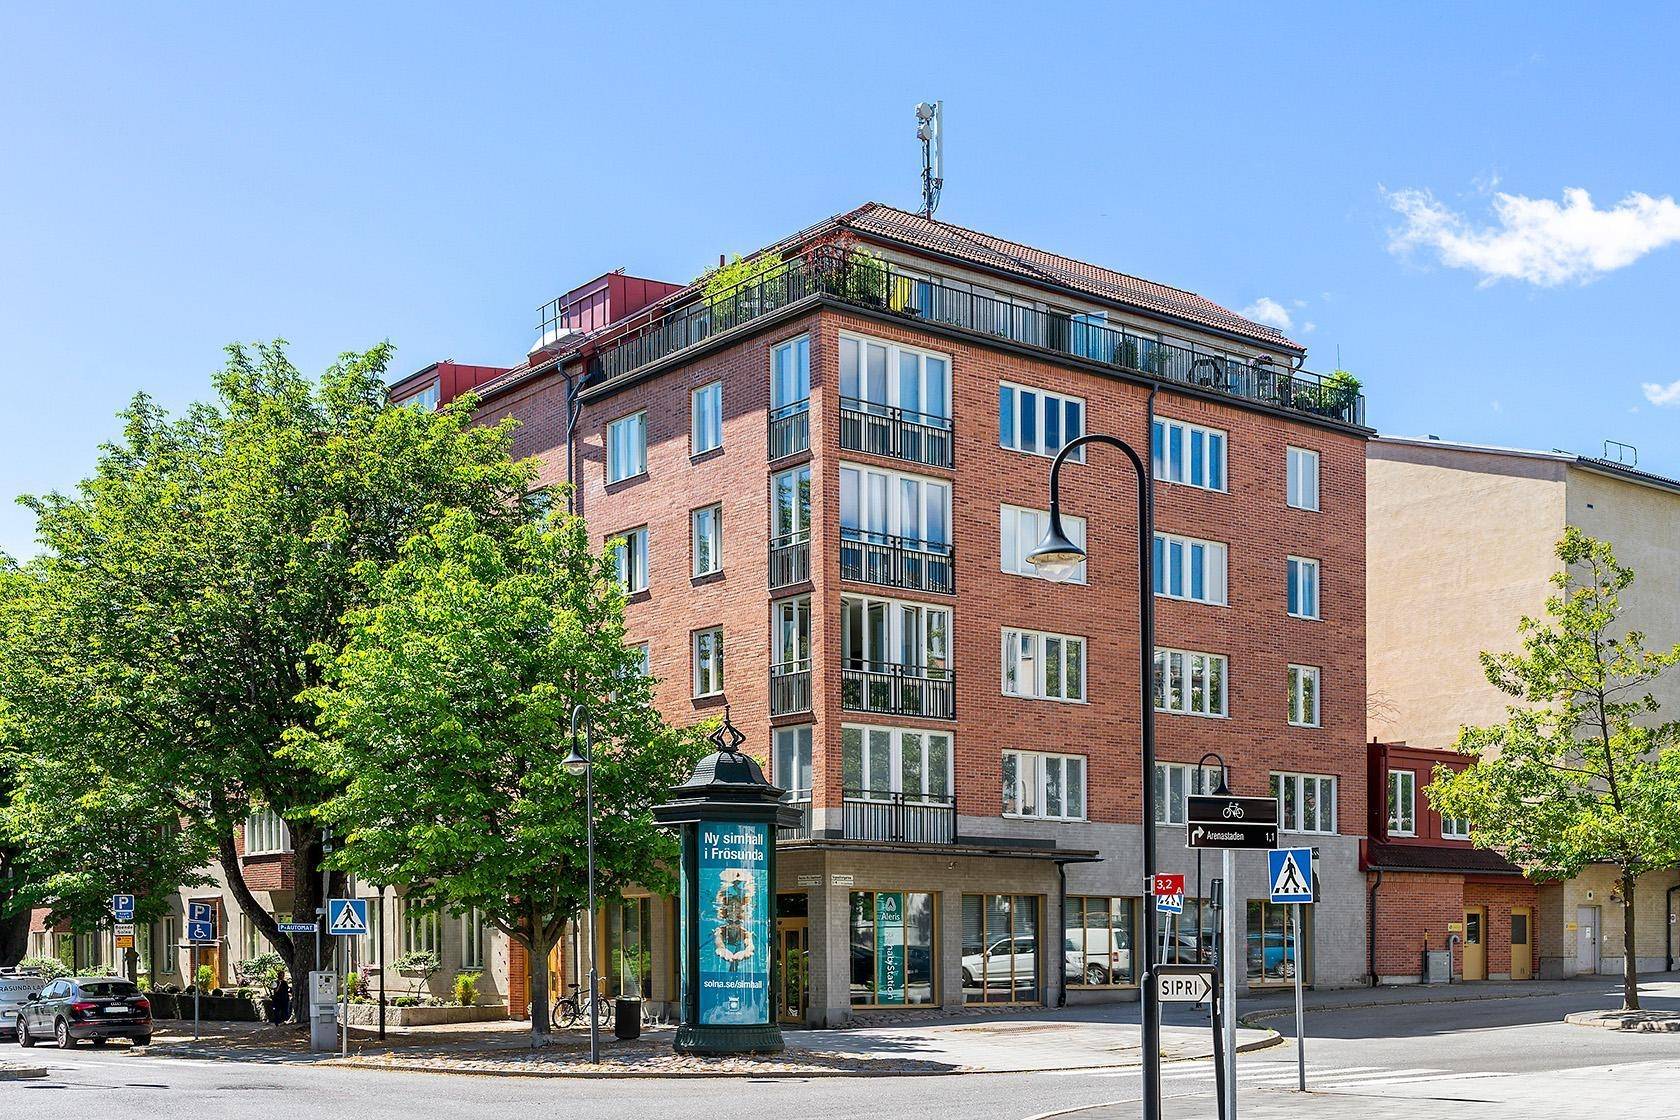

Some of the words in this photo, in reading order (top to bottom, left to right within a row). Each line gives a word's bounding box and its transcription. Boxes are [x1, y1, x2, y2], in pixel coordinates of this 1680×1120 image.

[704, 831, 719, 846] Ny
[723, 832, 763, 845] simhall
[1206, 830, 1244, 840] Arenastaden
[1265, 832, 1275, 842] 1,1
[704, 848, 708, 859] i
[711, 847, 763, 861] Frösunda
[1156, 879, 1172, 890] 3,2
[1176, 886, 1182, 894] A
[119, 896, 128, 909] P
[194, 905, 205, 919] P
[881, 912, 900, 921] Aleris
[703, 980, 763, 989] solna.se/simhall
[1162, 980, 1197, 996] SIPRI
